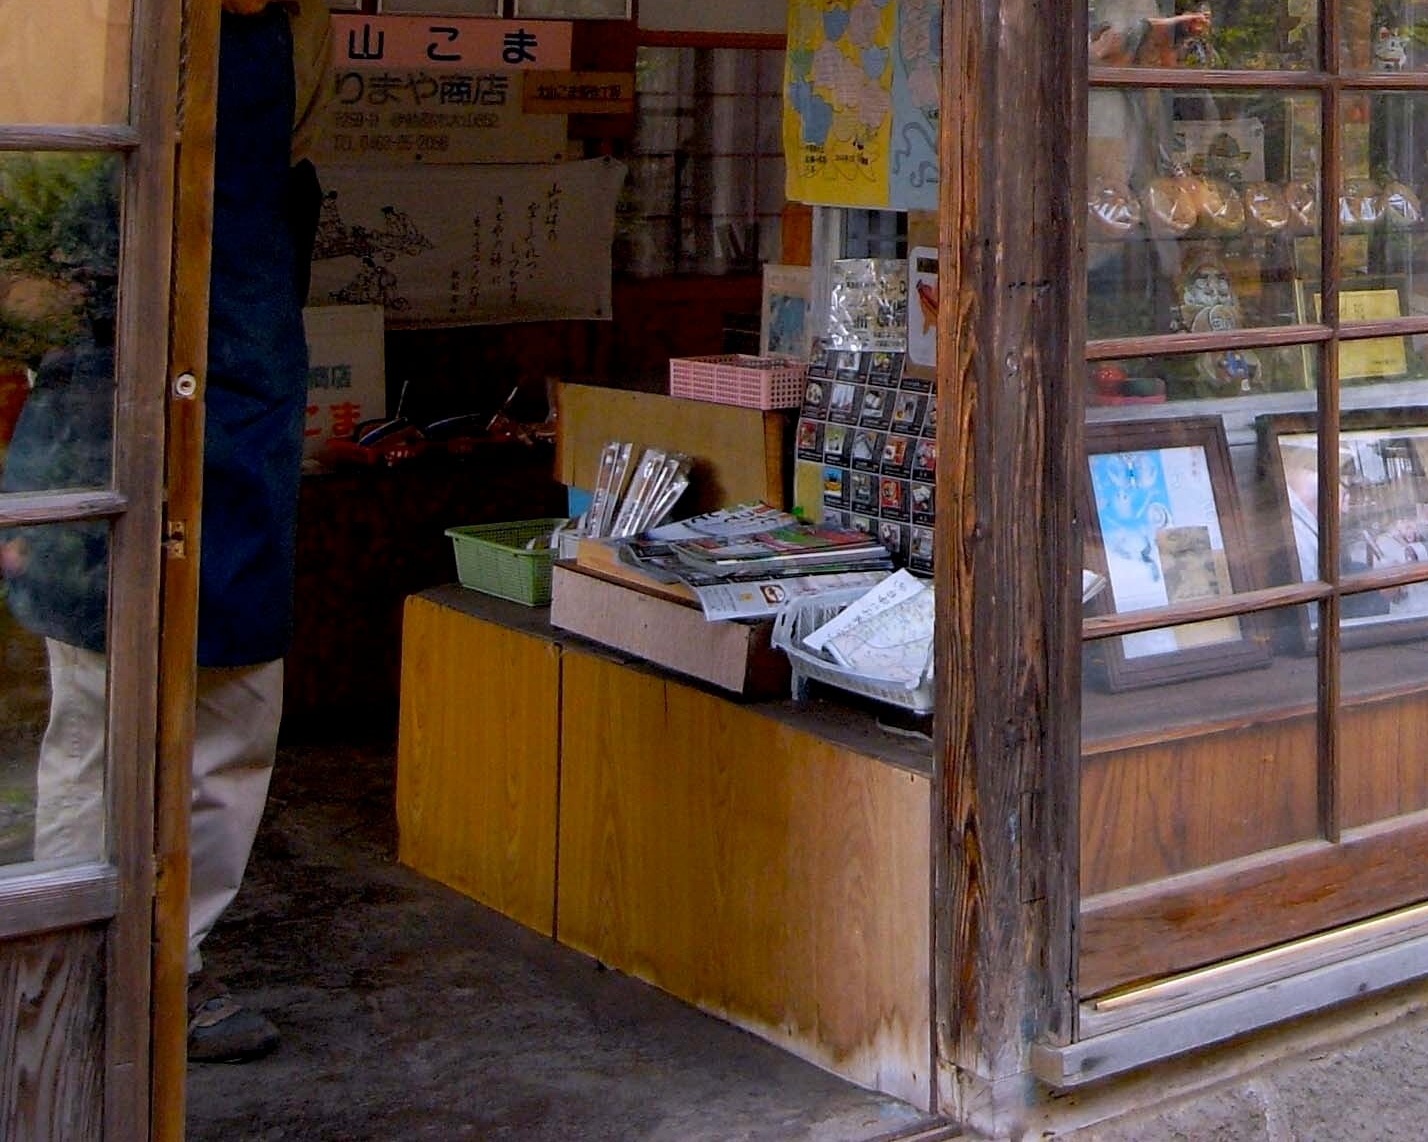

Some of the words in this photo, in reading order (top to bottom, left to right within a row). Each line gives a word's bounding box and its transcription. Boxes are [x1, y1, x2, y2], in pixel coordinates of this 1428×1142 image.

[347, 23, 539, 64] 山こま
[335, 71, 509, 108] りまや商店
